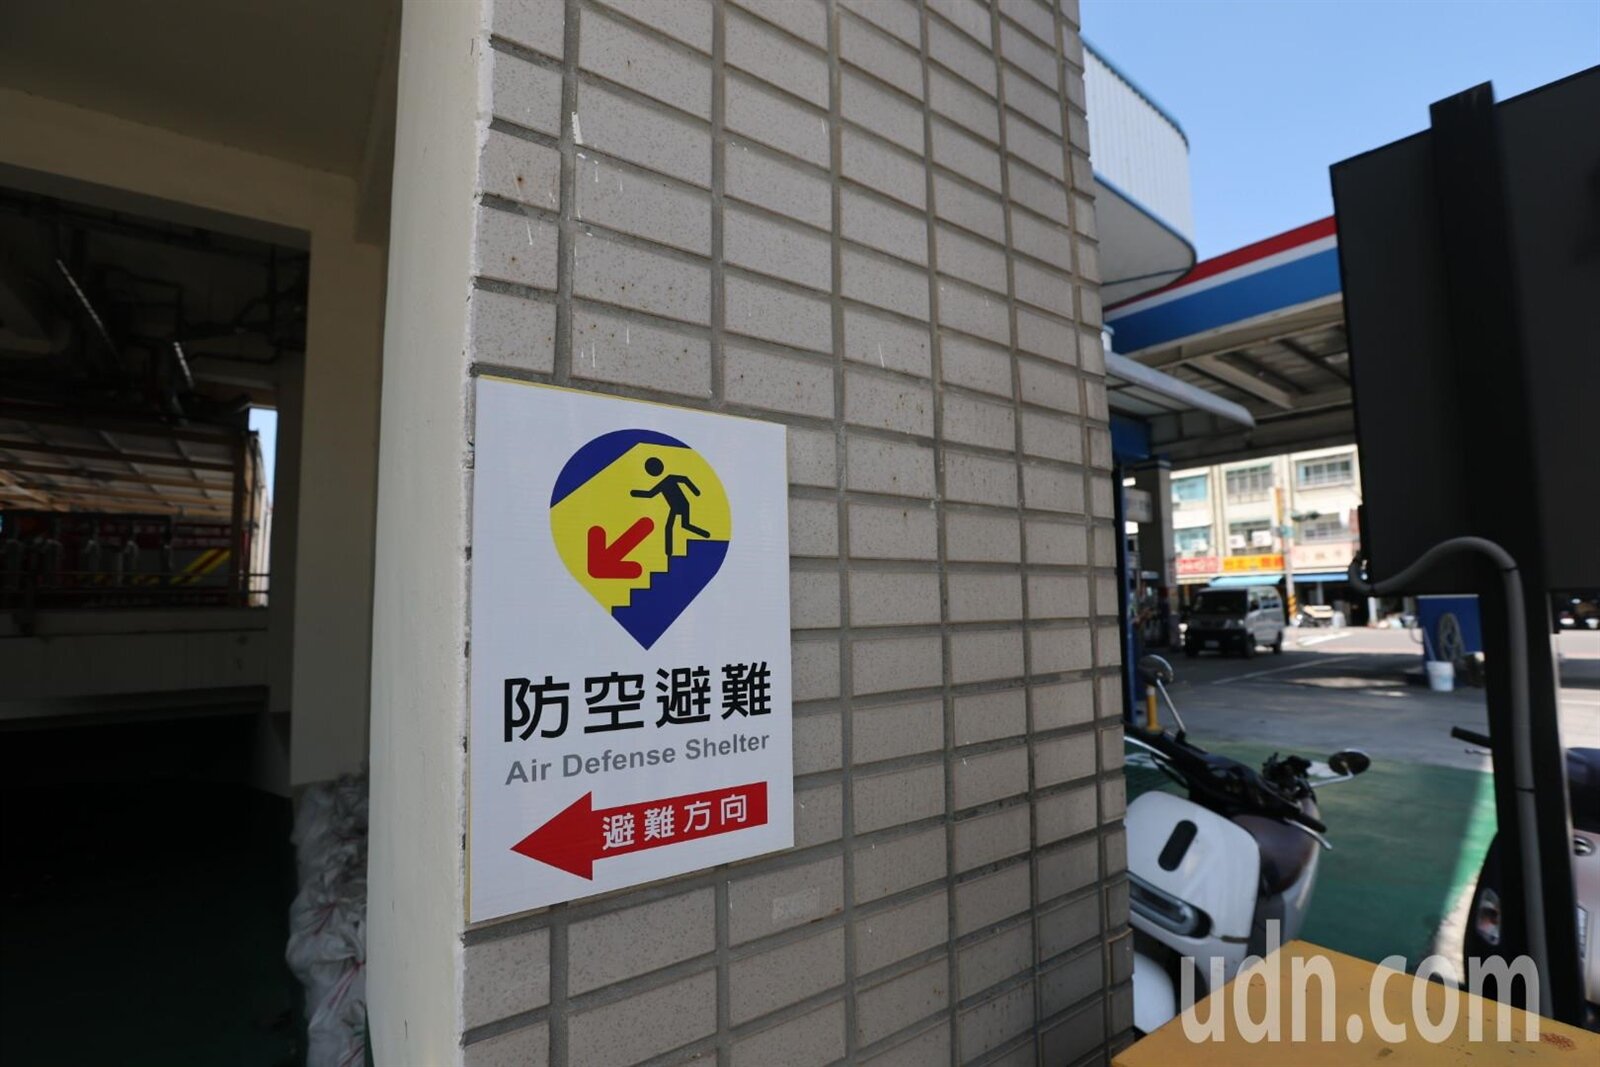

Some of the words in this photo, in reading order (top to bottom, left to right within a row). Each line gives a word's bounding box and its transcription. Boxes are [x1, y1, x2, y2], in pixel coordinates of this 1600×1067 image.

[503, 661, 772, 742] 防空避難
[505, 760, 551, 785] Air
[562, 748, 676, 777] Defense
[685, 732, 770, 760] Shelter
[602, 793, 748, 850] 避難方向
